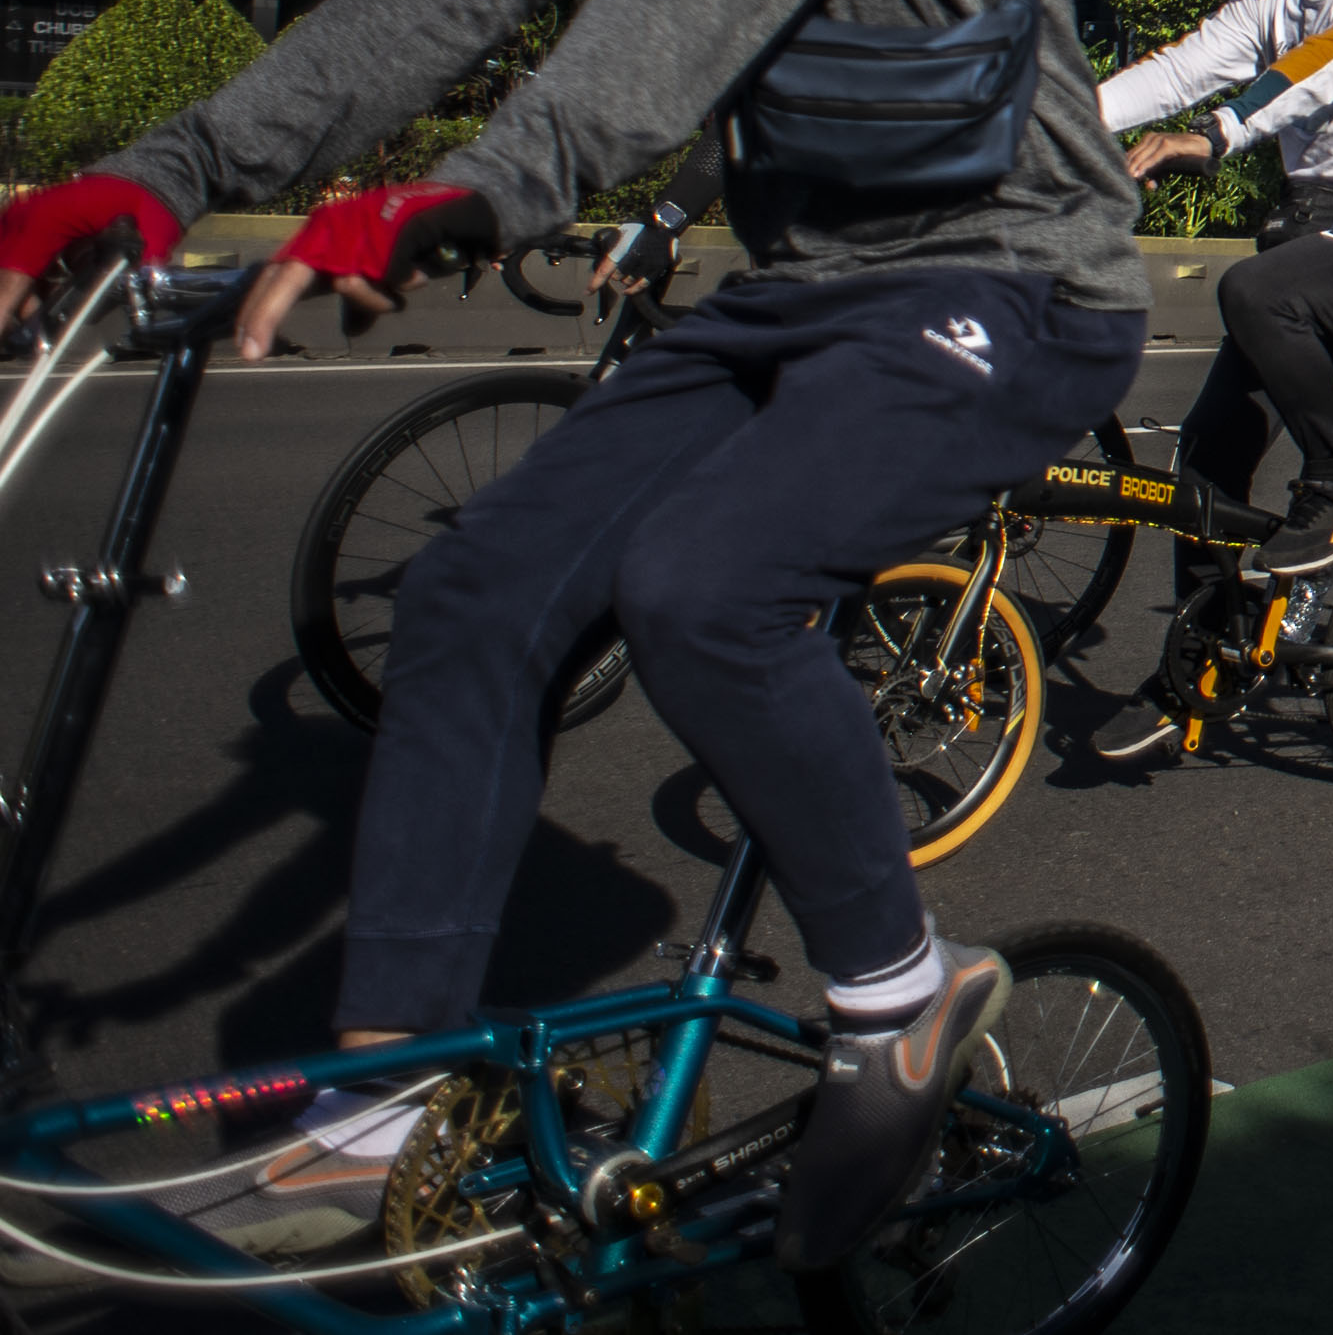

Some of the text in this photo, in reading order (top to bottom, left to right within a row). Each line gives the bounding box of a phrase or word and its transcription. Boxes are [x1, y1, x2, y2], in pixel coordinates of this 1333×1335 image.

[921, 328, 994, 376] CONVERSE
[1046, 466, 1176, 505] POLICE BROBOT
